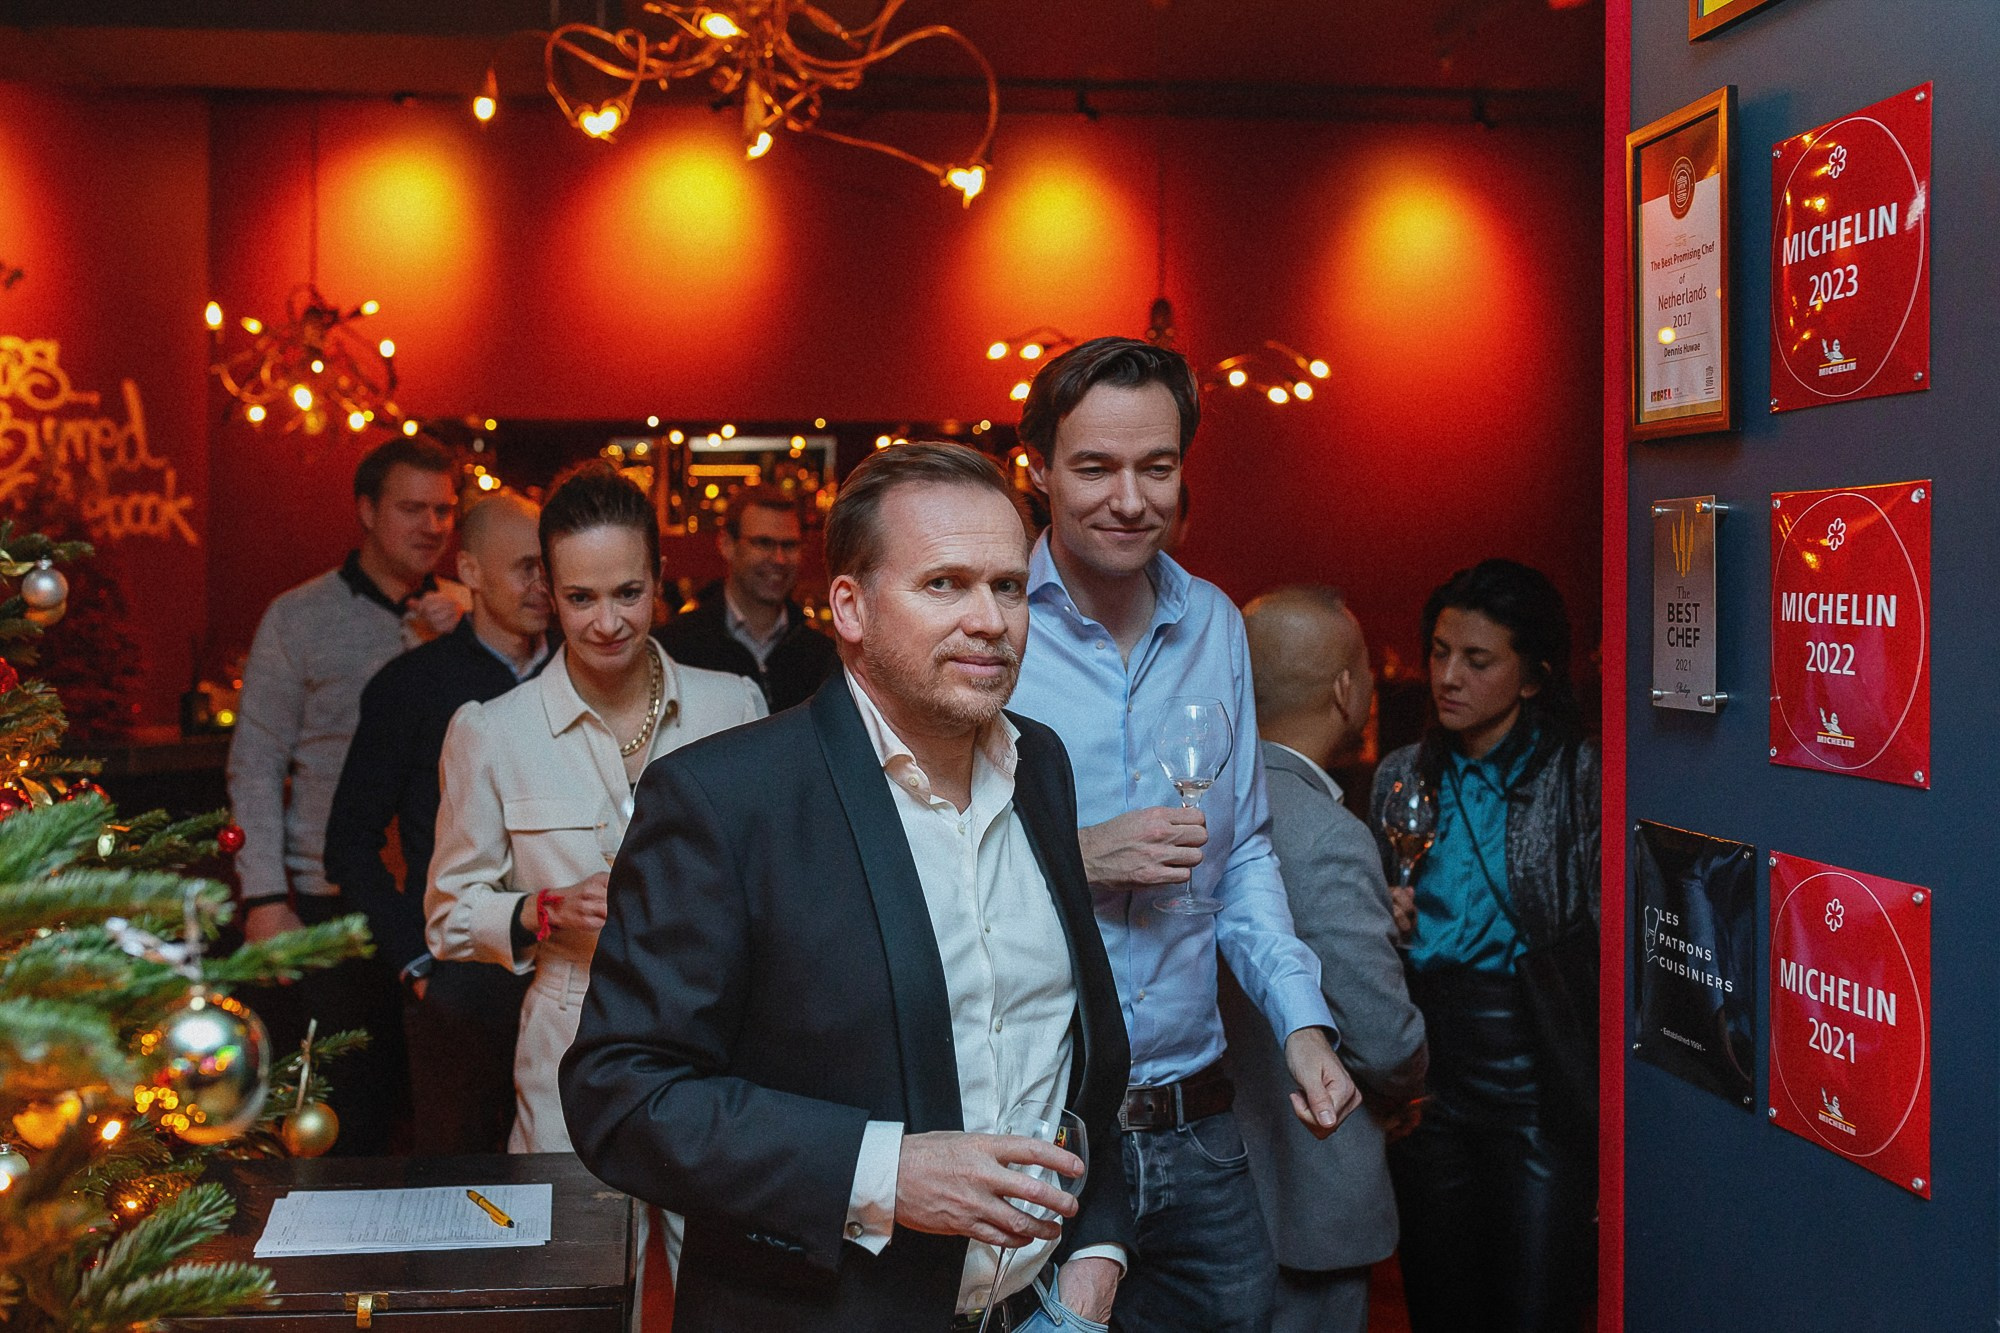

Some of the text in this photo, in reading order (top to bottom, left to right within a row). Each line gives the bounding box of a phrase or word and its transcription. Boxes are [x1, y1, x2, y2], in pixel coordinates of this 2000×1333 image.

[1782, 202, 1898, 267] MICHELIN
[1650, 260, 1661, 272] The
[1661, 257, 1673, 269] Best
[1673, 247, 1702, 265] Promising
[1701, 240, 1715, 255] Chef
[1678, 272, 1686, 285] of
[1809, 264, 1859, 307] 2023
[1658, 282, 1707, 311] Netherlands
[1672, 312, 1692, 328] 2017
[1663, 344, 1683, 358] Dennis
[1818, 362, 1857, 377] MICHELIN
[1676, 585, 1691, 600] The
[1667, 602, 1700, 624] BEST
[1781, 591, 1898, 628] MICHELIN
[1666, 626, 1701, 648] CHEF
[1675, 658, 1692, 672] 2021
[1805, 640, 1856, 676] 2022
[1816, 734, 1855, 749] MICHELIN
[1659, 909, 1679, 927] LES
[1659, 932, 1712, 962] PATRONS
[1659, 955, 1733, 993] CUISINIERS
[1780, 957, 1897, 1027] MICHELIN
[1808, 1017, 1855, 1064] 2021
[1818, 1112, 1857, 1137] MICHELIN
